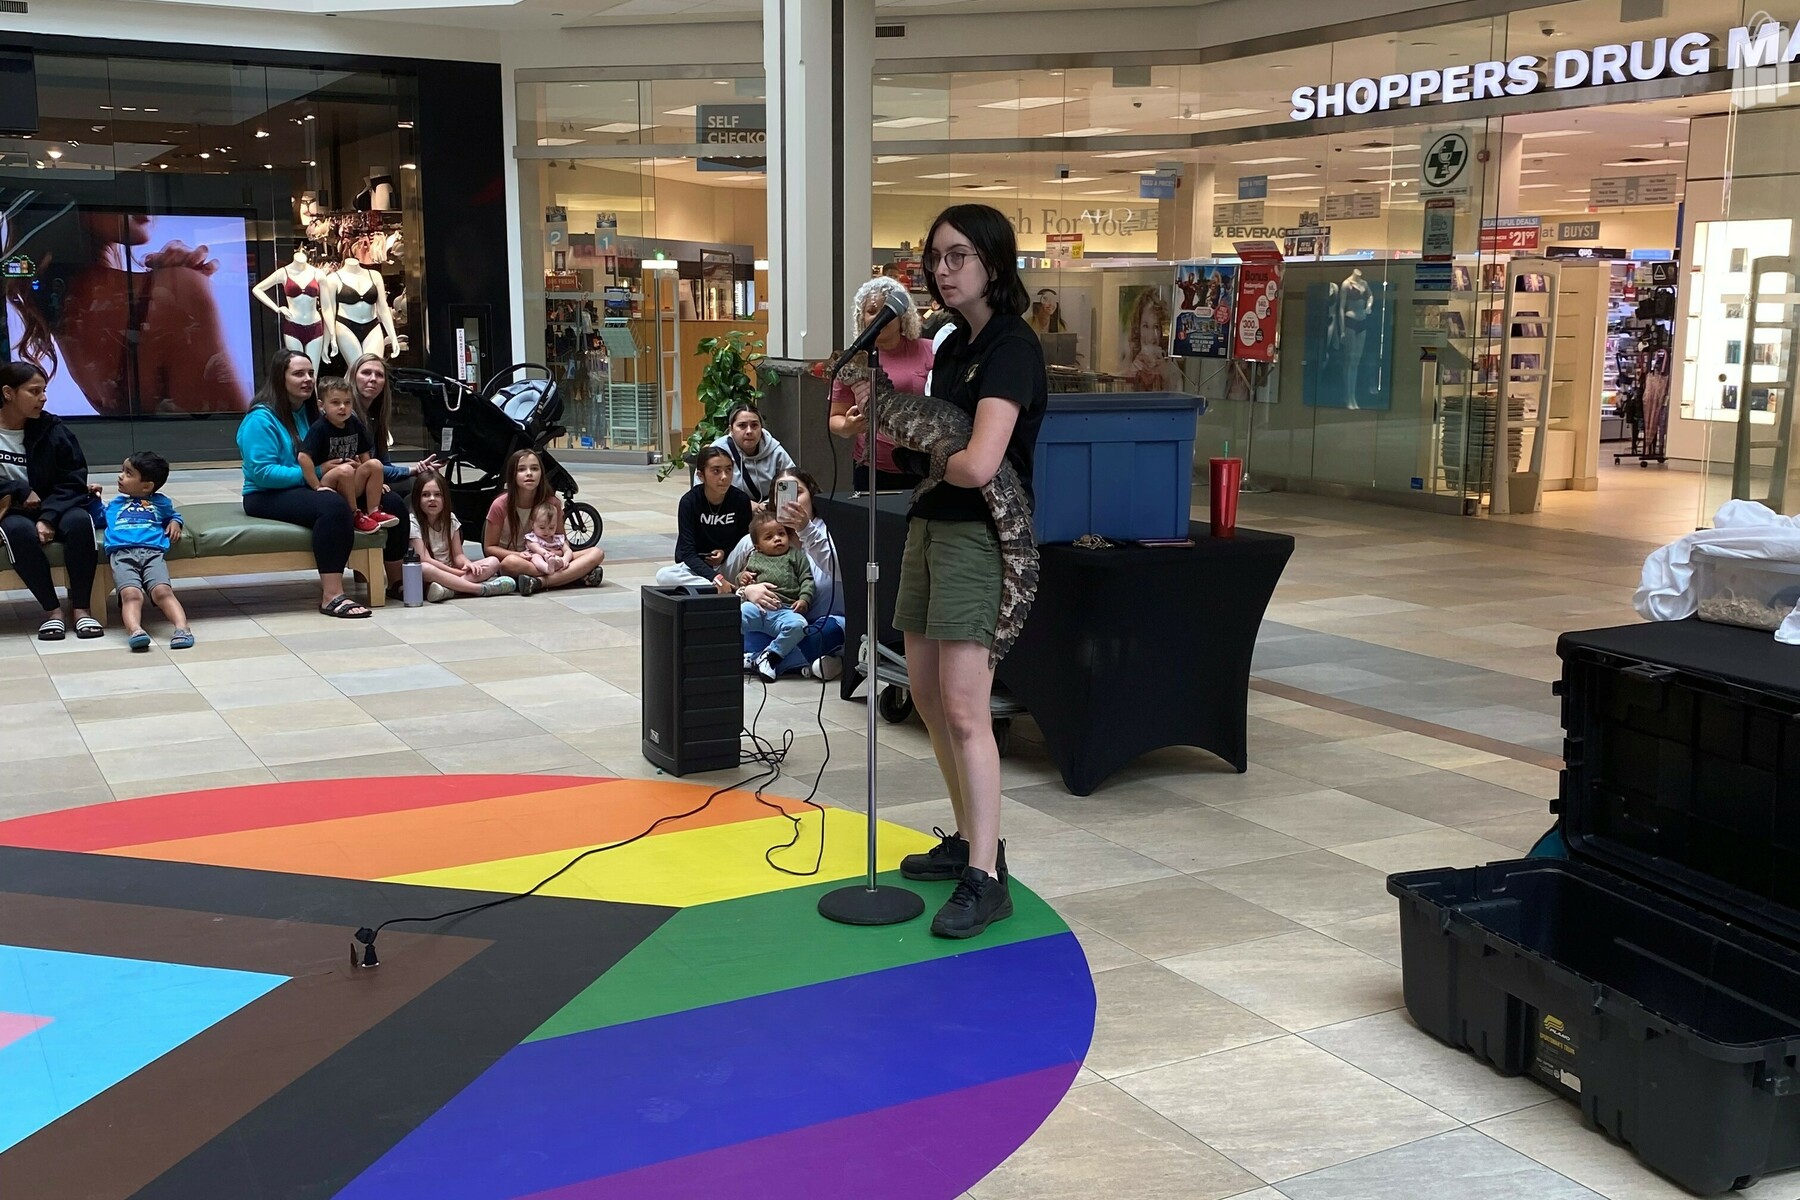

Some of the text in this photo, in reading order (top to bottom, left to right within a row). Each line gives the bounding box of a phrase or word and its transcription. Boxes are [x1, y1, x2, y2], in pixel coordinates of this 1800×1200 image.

[1289, 56, 1542, 121] SHOPPERS
[1554, 32, 1711, 89] DRUG
[708, 115, 739, 128] SELF
[708, 131, 766, 144] CHECKO
[1626, 189, 1637, 204] 3
[1041, 209, 1083, 235] For
[1086, 210, 1133, 237] You
[1516, 217, 1538, 226] DEALS!
[550, 231, 561, 245] 2
[1213, 227, 1224, 238] &
[1227, 227, 1286, 238] BEVERAG
[1541, 225, 1594, 238] at BUYS!
[602, 236, 609, 250] 1
[1245, 271, 1269, 281] Bonus
[700, 512, 736, 525] NIKE
